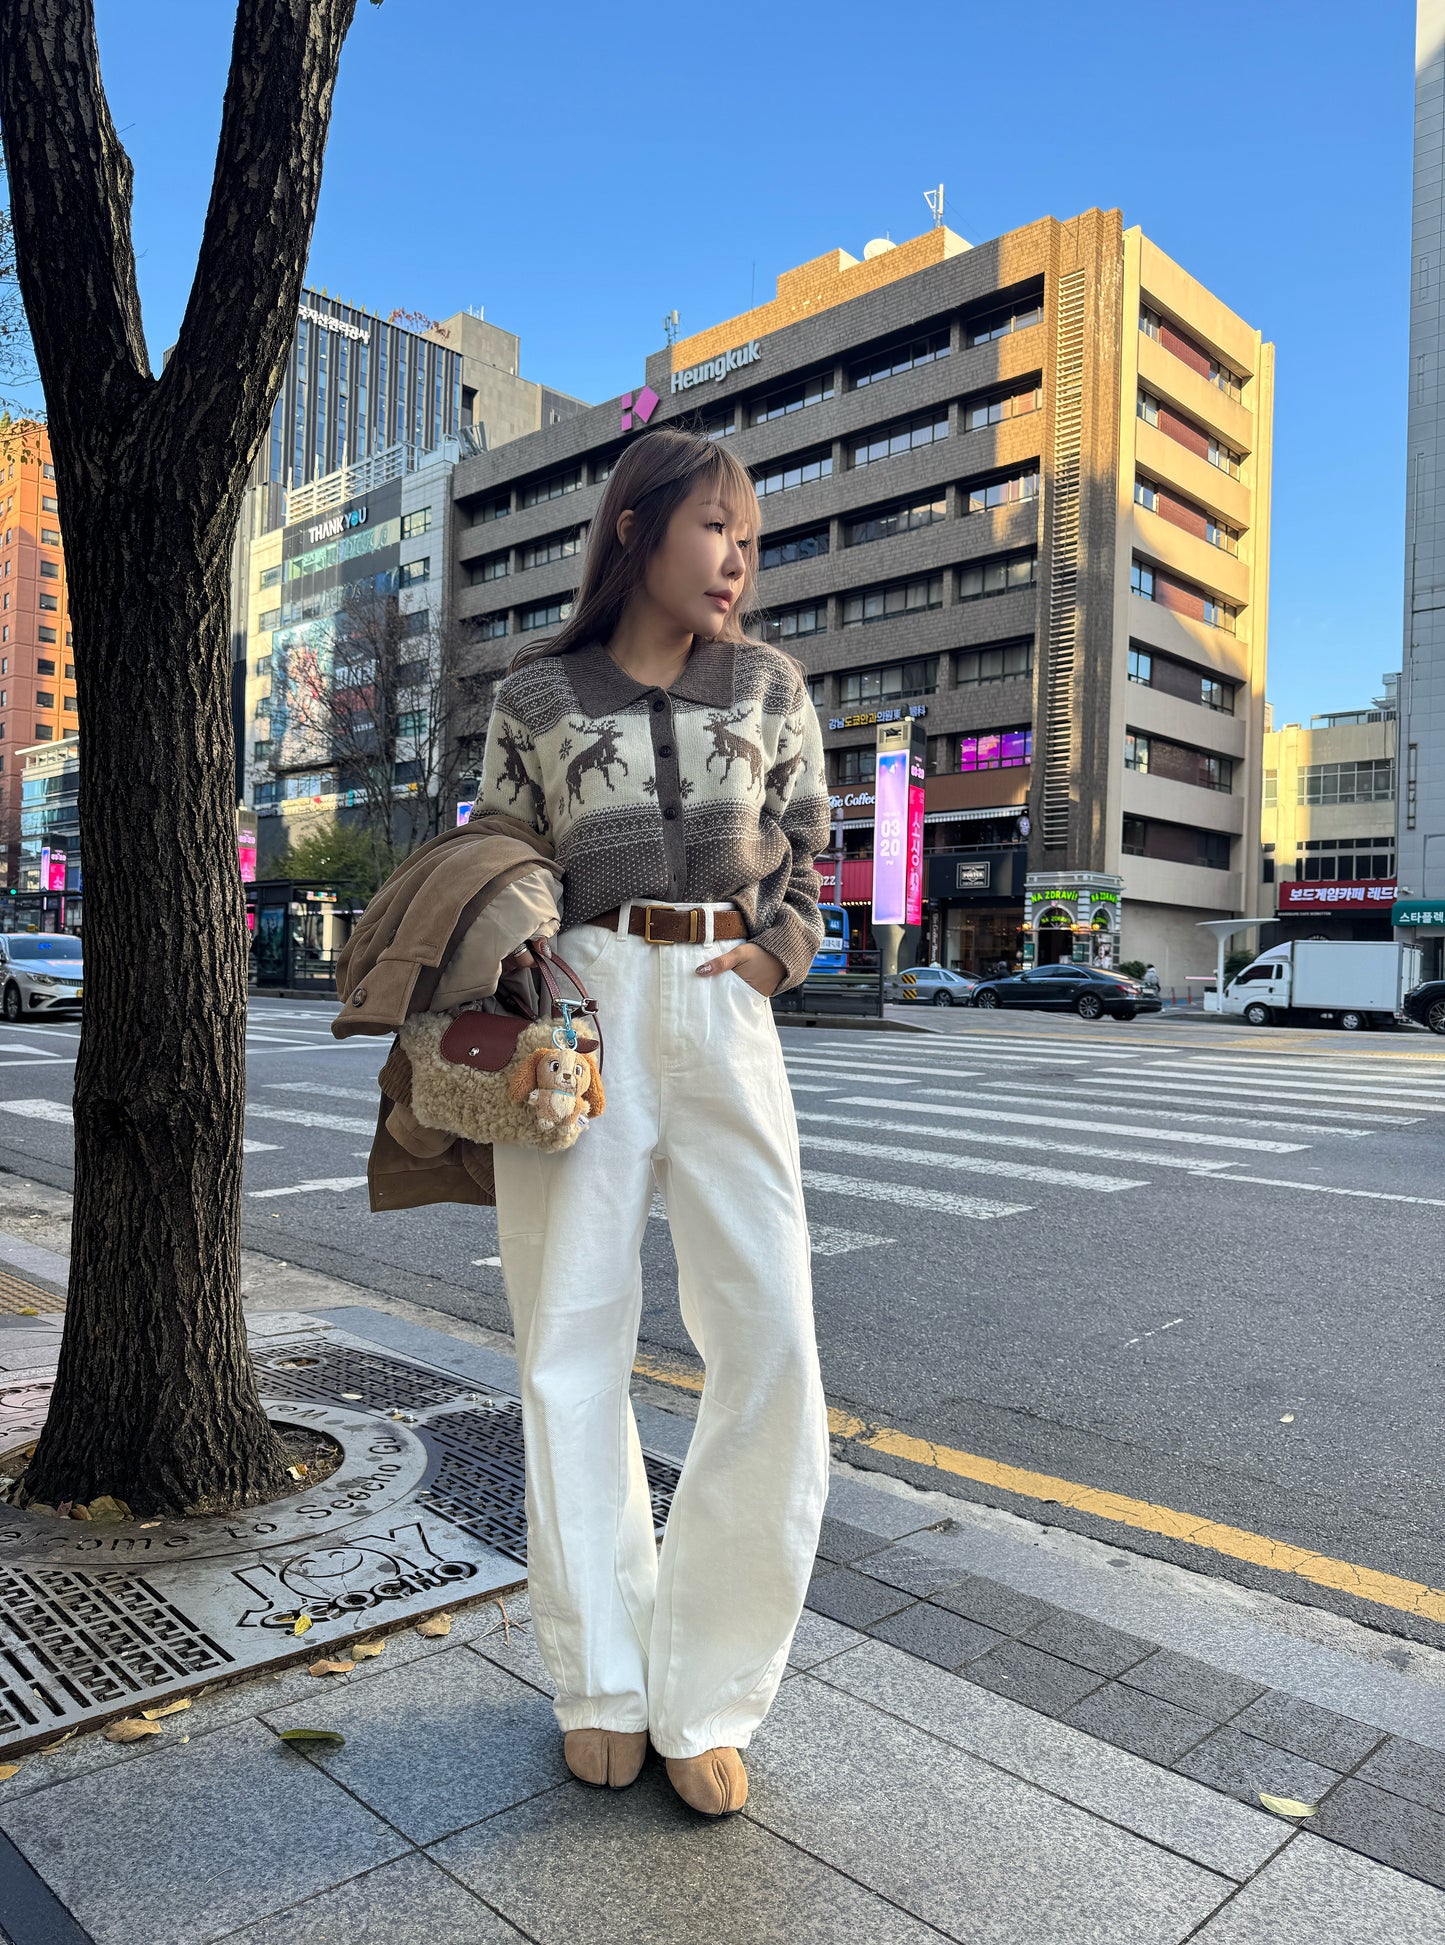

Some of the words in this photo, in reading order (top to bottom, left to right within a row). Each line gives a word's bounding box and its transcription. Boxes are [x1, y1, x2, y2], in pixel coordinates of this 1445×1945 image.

[671, 340, 762, 394] Heungkuk
[308, 515, 344, 544] THANK
[344, 506, 367, 529] YOU
[881, 819, 901, 838] 03
[880, 839, 901, 857] 20
[1031, 893, 1043, 904] NA
[1289, 887, 1363, 902] 보드게임카페
[1367, 887, 1398, 900] 레드
[1399, 911, 1445, 923] 스타플렉
[0, 1530, 190, 1551] elcome
[222, 1522, 278, 1540] to
[295, 1464, 402, 1519] Seocho
